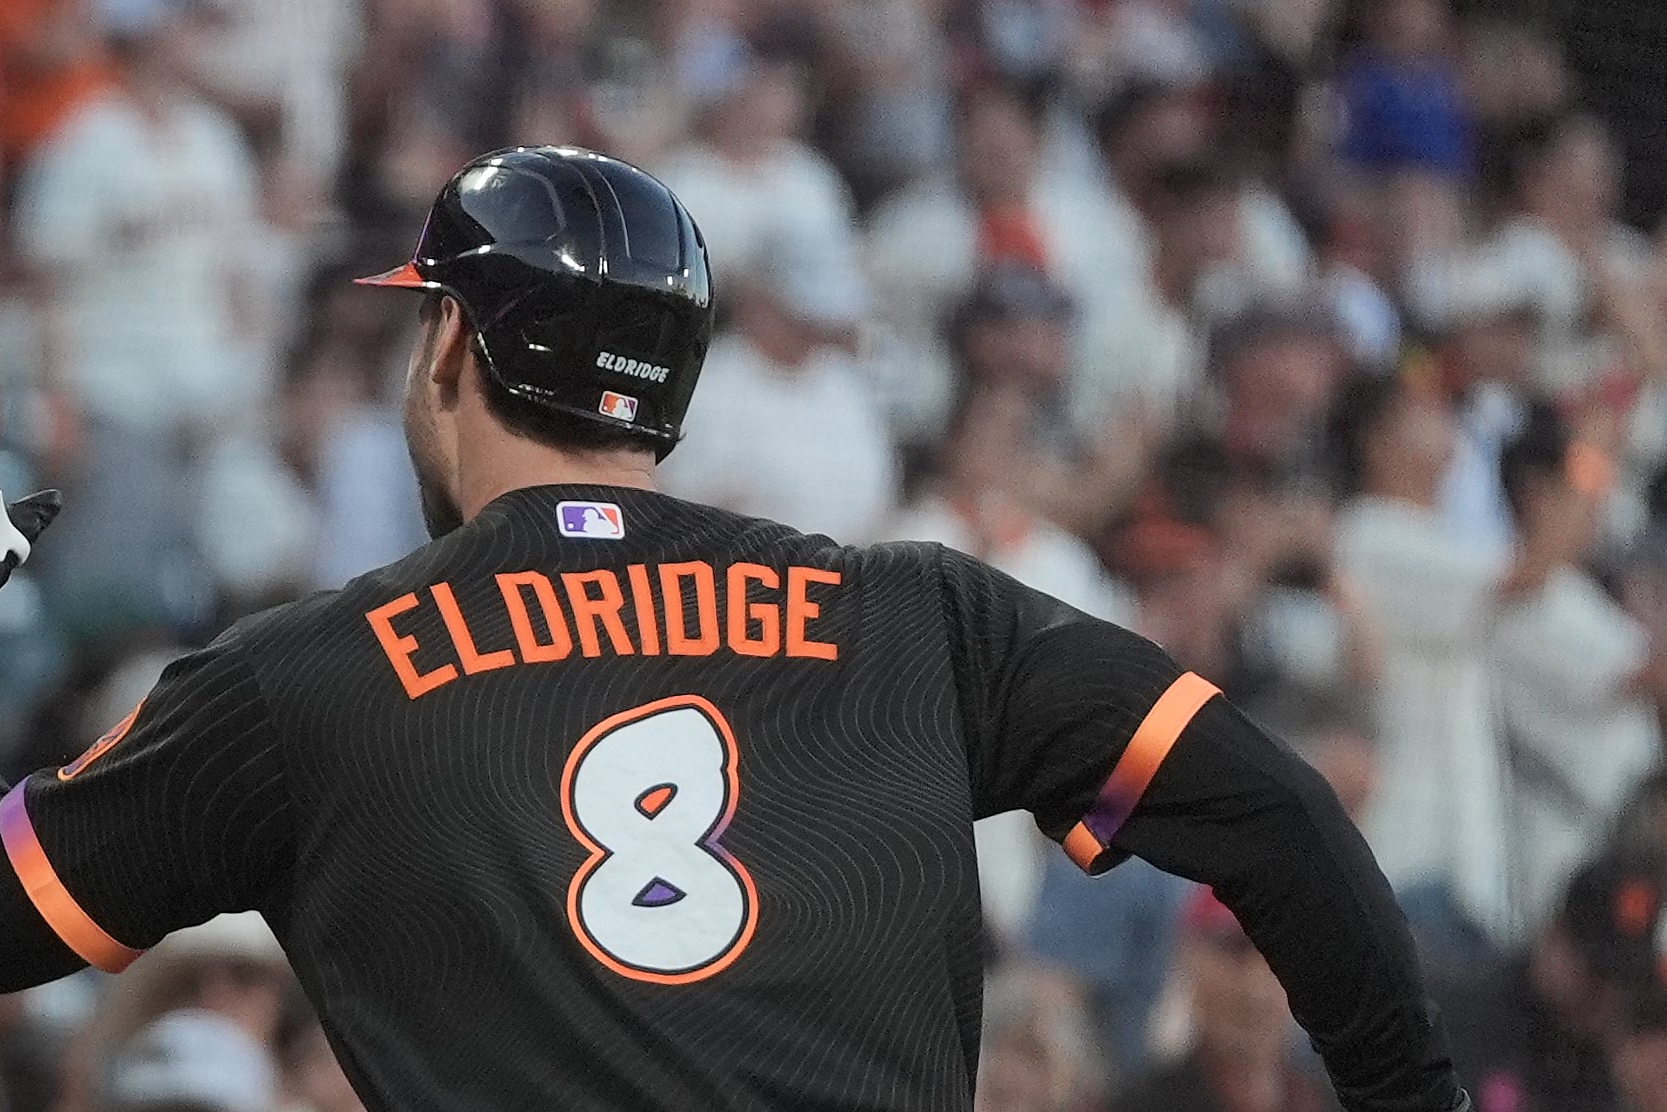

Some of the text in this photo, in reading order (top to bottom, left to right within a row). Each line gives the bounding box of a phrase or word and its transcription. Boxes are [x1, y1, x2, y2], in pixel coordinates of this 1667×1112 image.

[596, 351, 670, 384] ELDRIDGE
[365, 560, 842, 700] ELDRIDGE
[561, 694, 759, 985] 8
